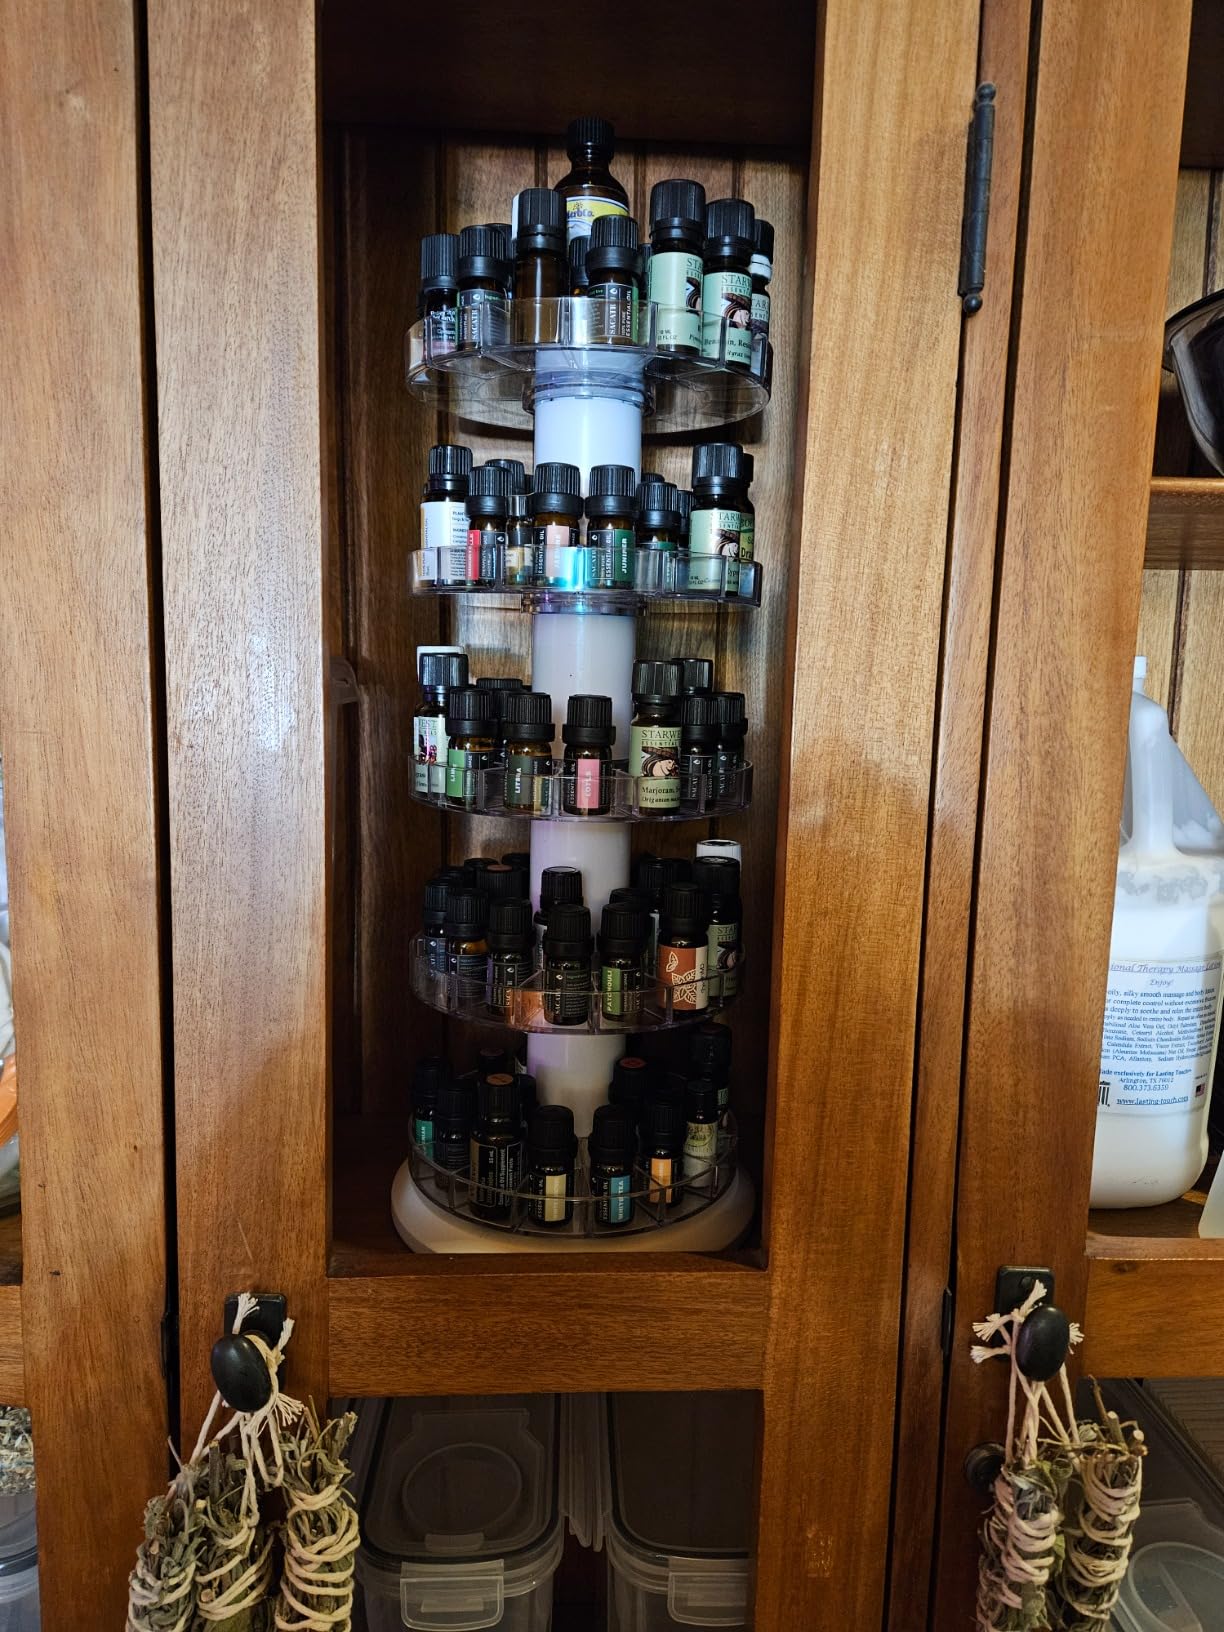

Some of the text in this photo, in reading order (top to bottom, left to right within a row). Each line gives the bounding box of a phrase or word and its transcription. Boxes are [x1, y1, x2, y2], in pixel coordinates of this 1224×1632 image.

[1140, 990, 1162, 998] smooth
[1113, 998, 1141, 1007] complete
[1142, 999, 1163, 1007] control
[1110, 1005, 1130, 1015] deeply
[1140, 1006, 1159, 1015] soothe
[1160, 1007, 1170, 1015] and
[1113, 1069, 1145, 1078] exclusively
